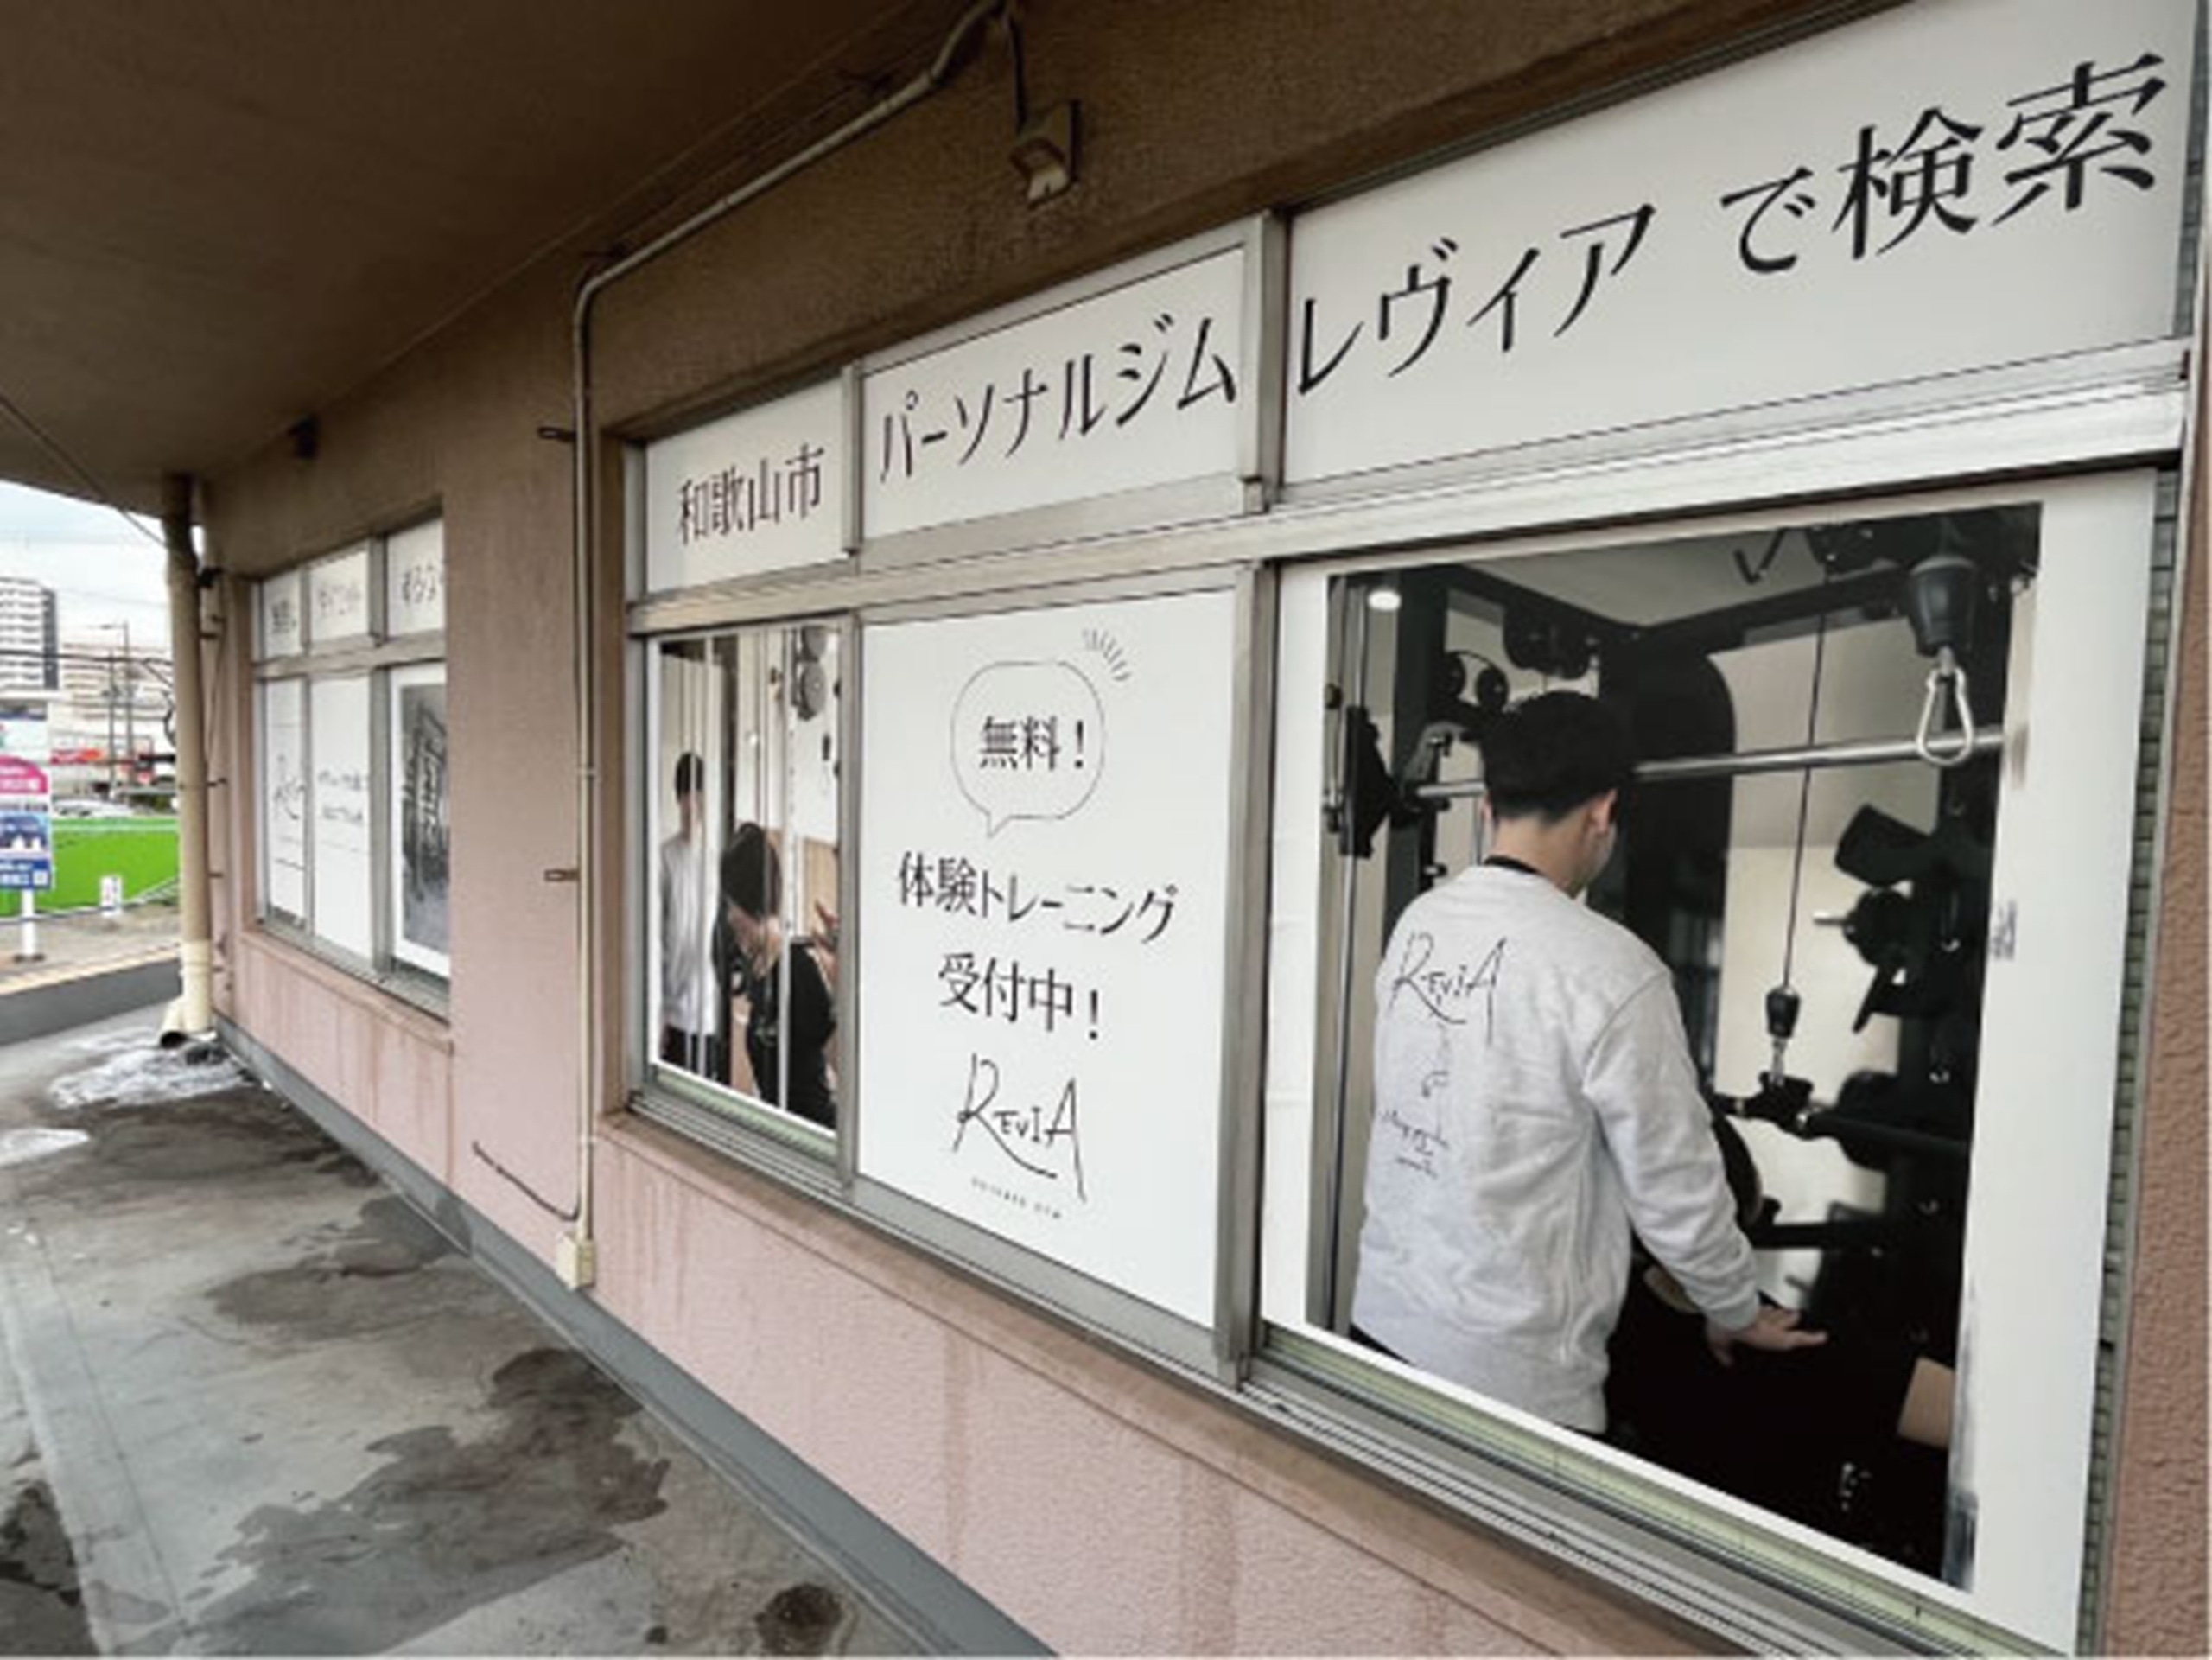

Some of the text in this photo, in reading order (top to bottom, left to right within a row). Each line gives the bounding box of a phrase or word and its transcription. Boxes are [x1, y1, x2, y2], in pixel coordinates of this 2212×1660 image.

[678, 52, 2167, 545] 和歌山市 パーソナルジム レヴィア で検索
[980, 716, 1085, 772] 無料！
[899, 851, 1179, 944] 体験トレーニング
[938, 952, 1100, 1040] 受付中！
